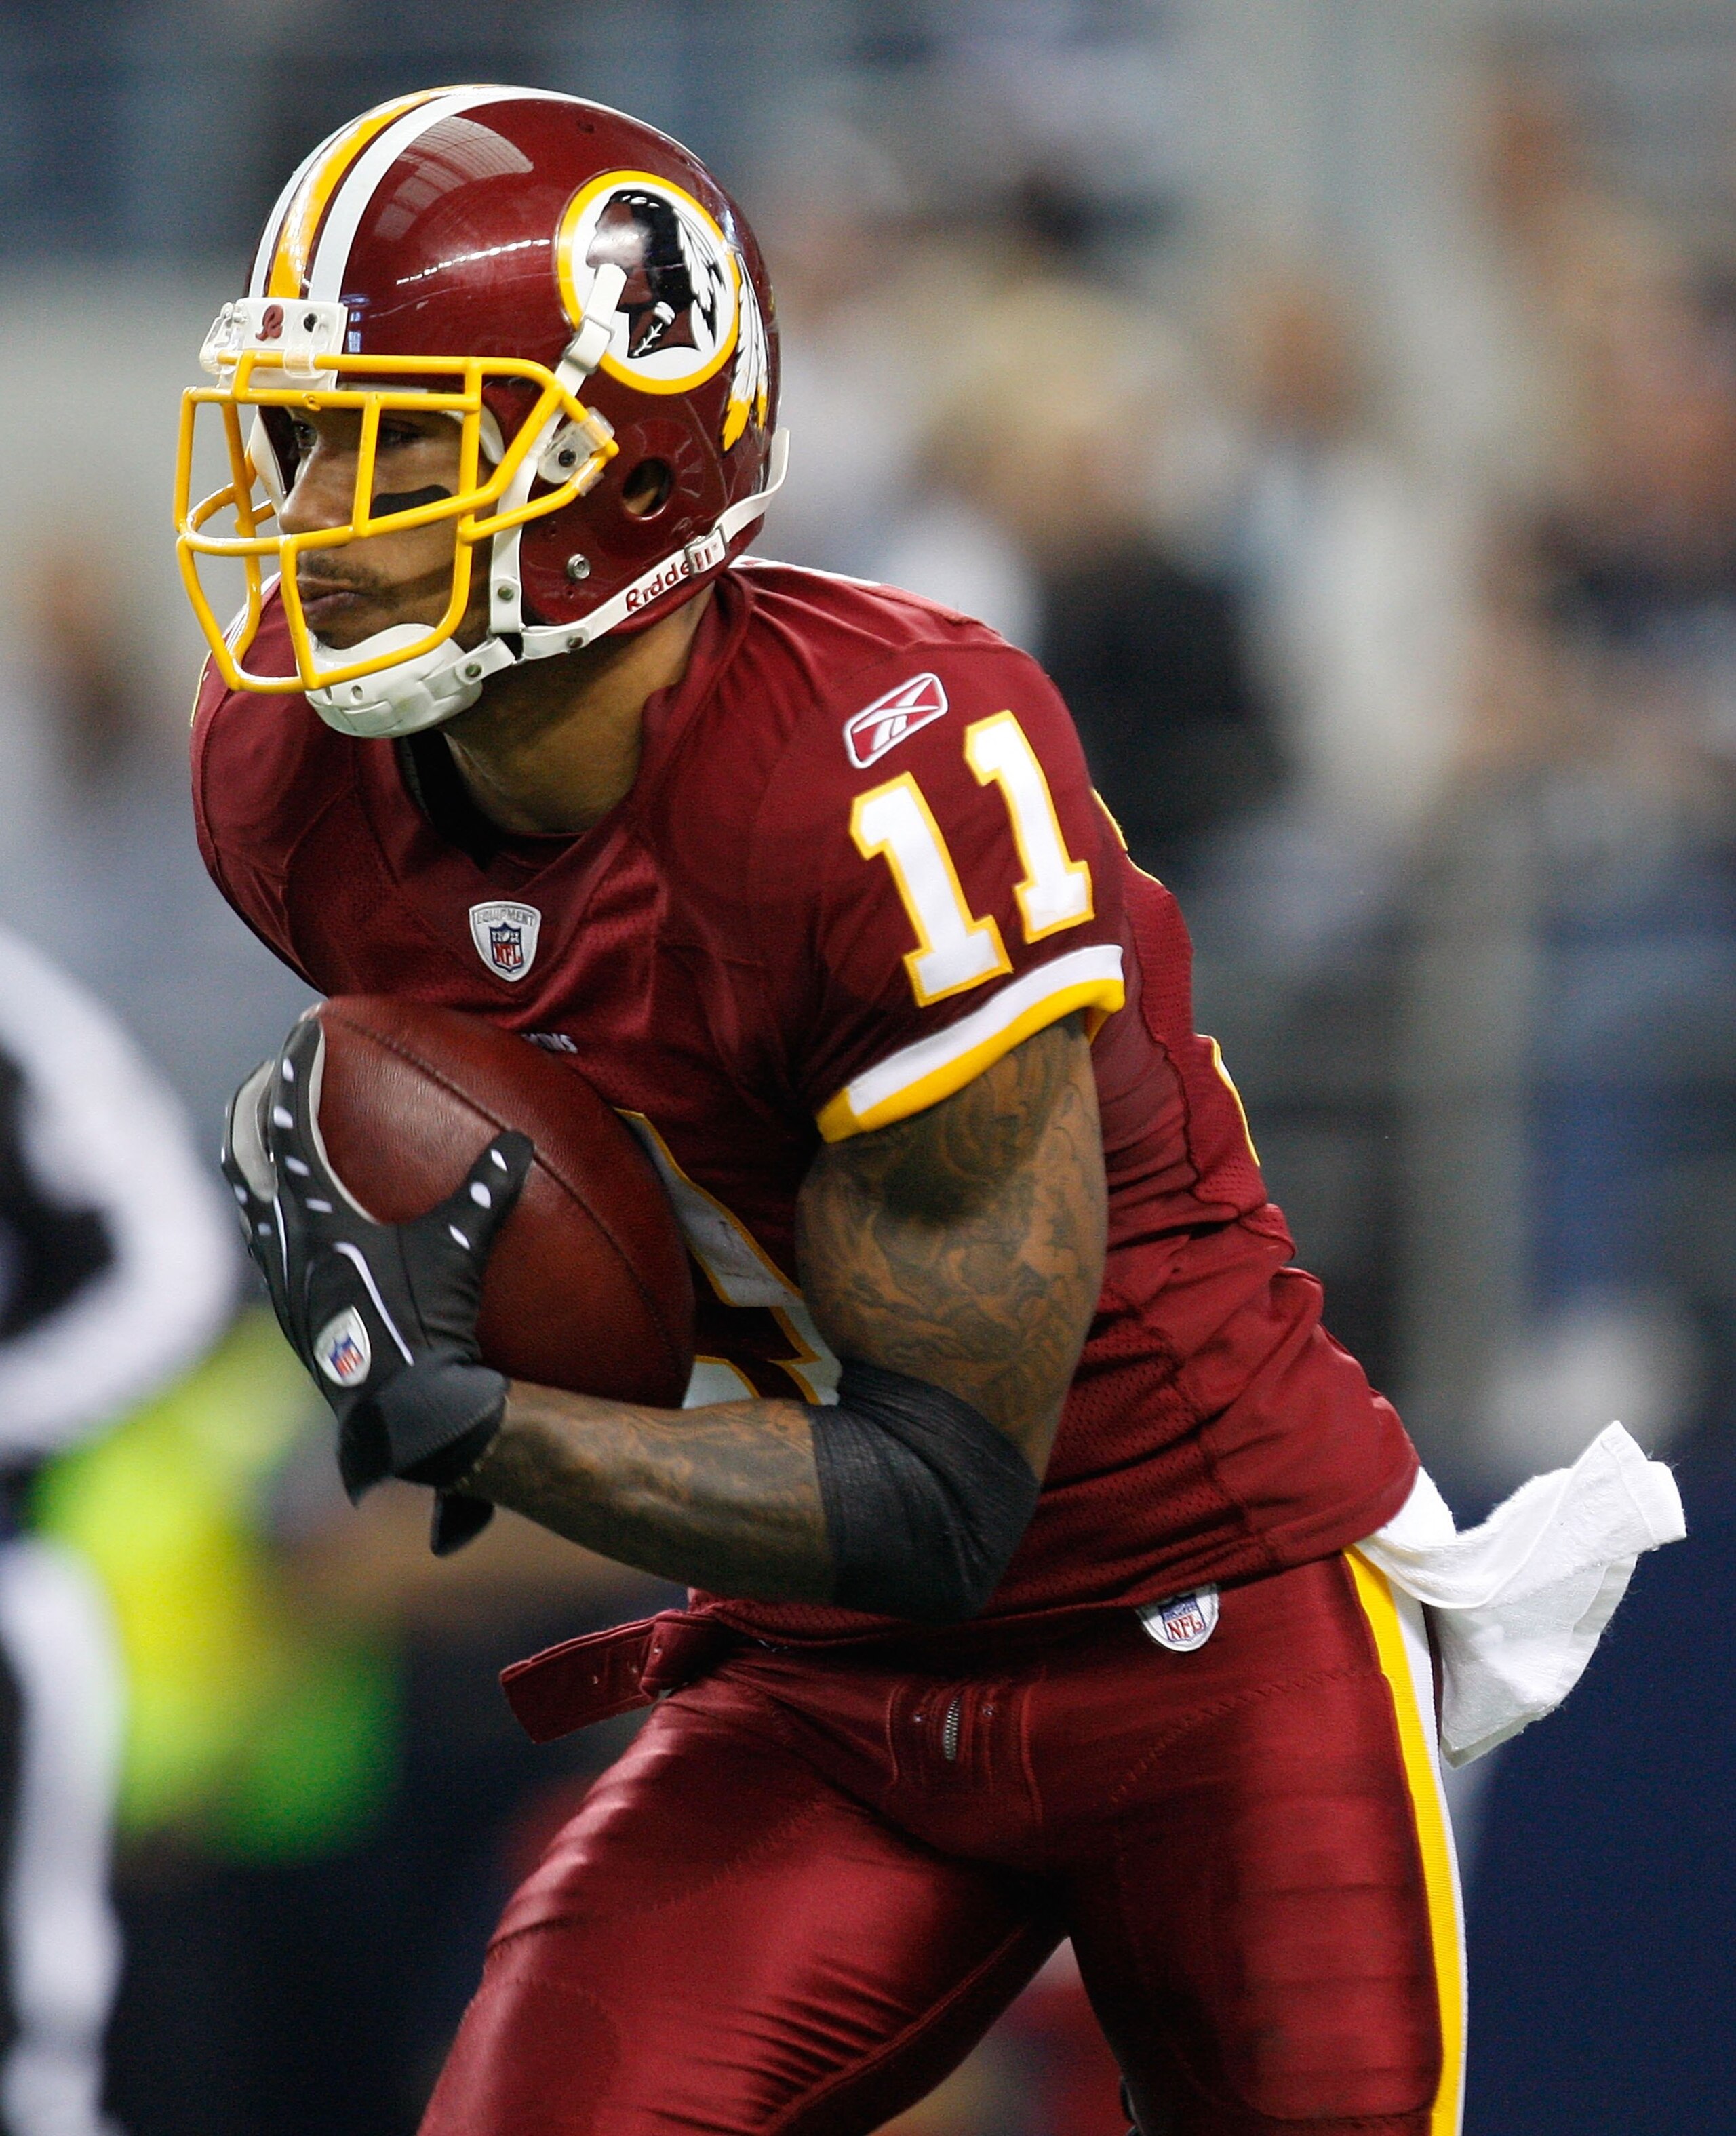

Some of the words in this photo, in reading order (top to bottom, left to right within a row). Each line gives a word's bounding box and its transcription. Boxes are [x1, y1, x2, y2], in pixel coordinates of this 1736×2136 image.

[849, 709, 1095, 1008] 11
[477, 907, 534, 927] EQUIPMENT
[493, 943, 521, 967] NFL
[1166, 1614, 1205, 1640] NFL
